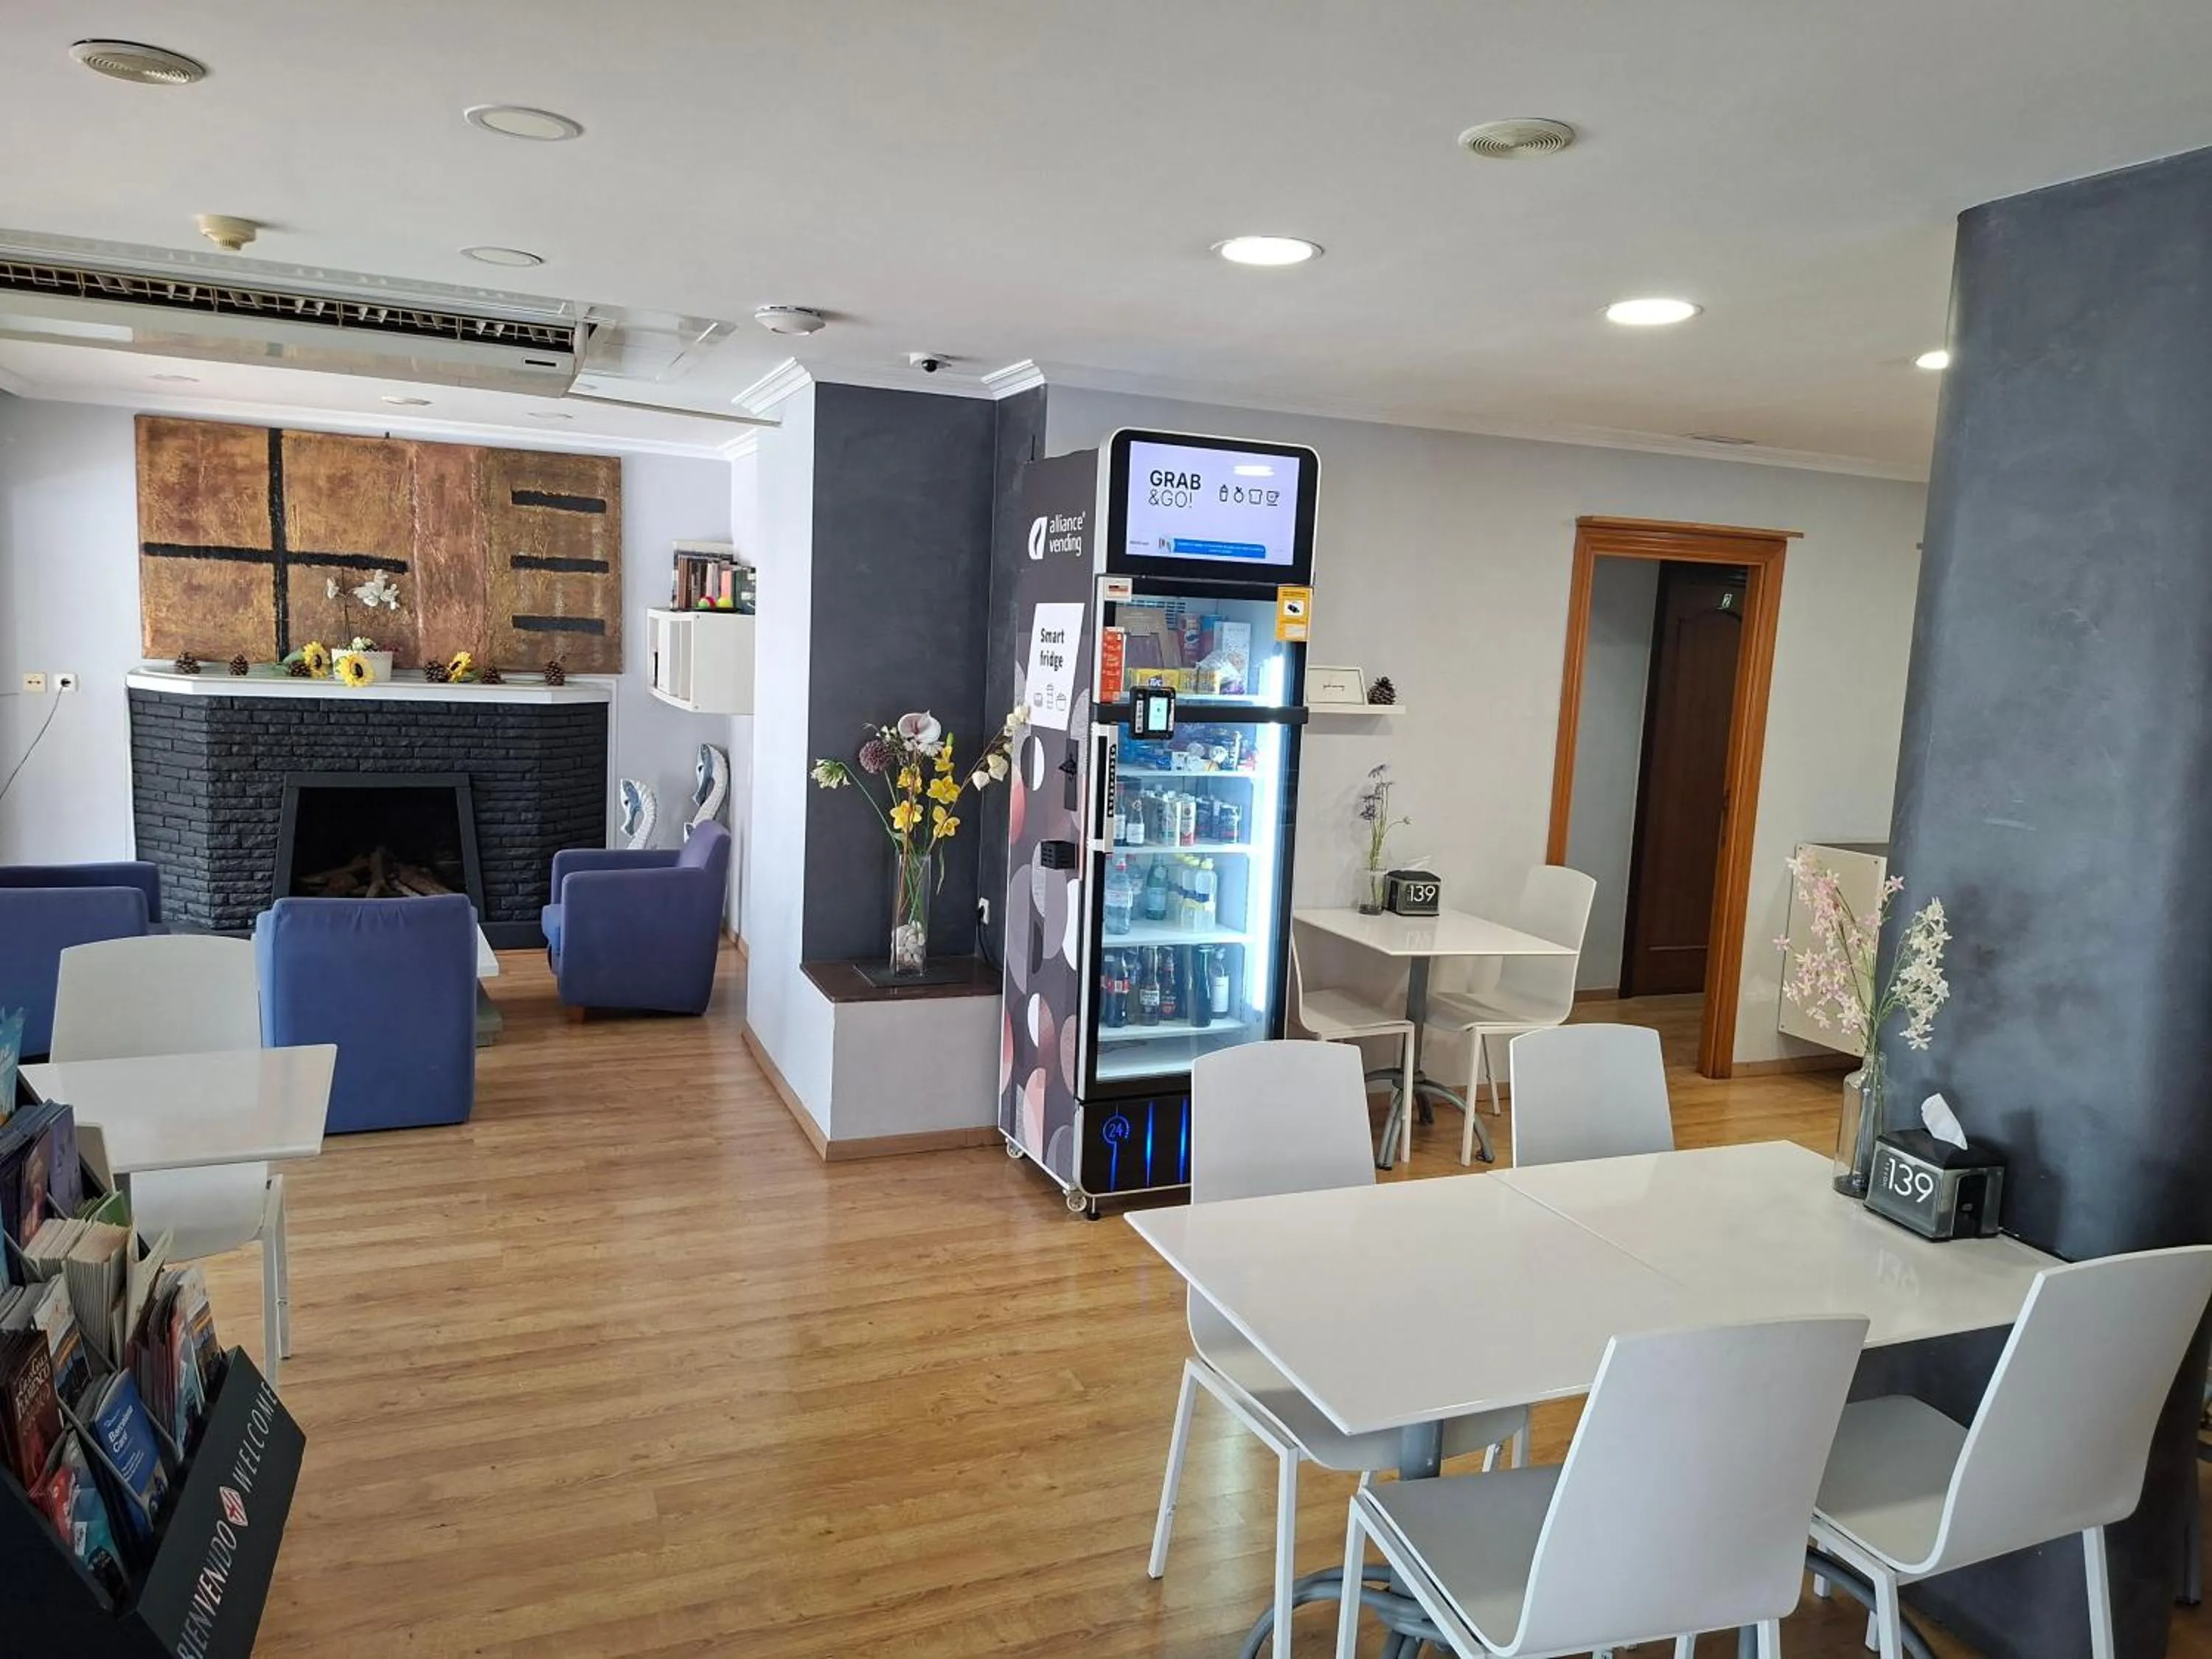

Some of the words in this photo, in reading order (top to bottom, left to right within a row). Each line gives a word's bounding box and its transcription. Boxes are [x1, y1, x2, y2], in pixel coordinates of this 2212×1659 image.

[1150, 470, 1201, 490] GRAB
[1149, 489, 1192, 508] &GO!
[1049, 533, 1082, 557] vending
[1040, 627, 1064, 644] Smart
[1040, 650, 1063, 672] fridge
[1410, 885, 1436, 902] 139
[1888, 1158, 1934, 1203] 139
[176, 1520, 237, 1659] BIENVENIDO
[232, 1381, 277, 1493] WELCOME
